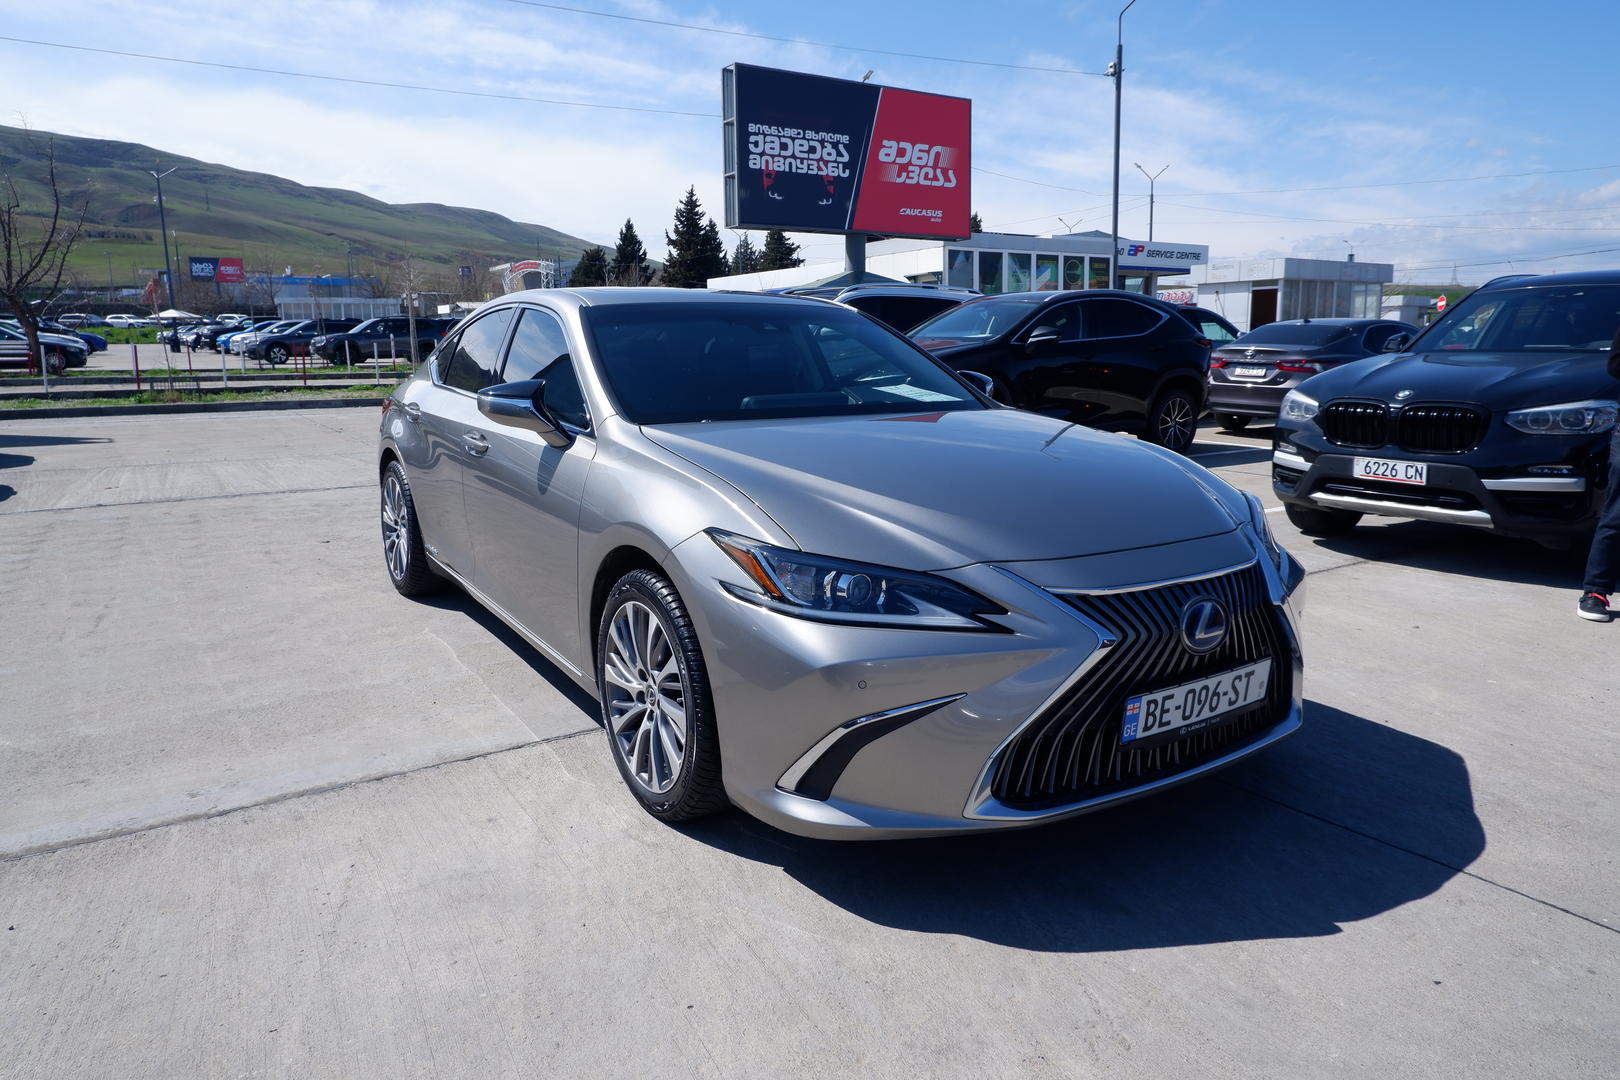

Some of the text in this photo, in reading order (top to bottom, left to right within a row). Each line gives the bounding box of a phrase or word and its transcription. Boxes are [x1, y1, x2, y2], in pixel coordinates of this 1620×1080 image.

[748, 135, 850, 162] ქმედება
[899, 207, 943, 217] CAUCASUS
[1146, 249, 1175, 259] SERVICE
[1175, 251, 1202, 261] CENTRE
[1364, 461, 1424, 481] 6226 CN
[1142, 670, 1255, 732] BE-096-ST
[1123, 722, 1138, 737] GE
